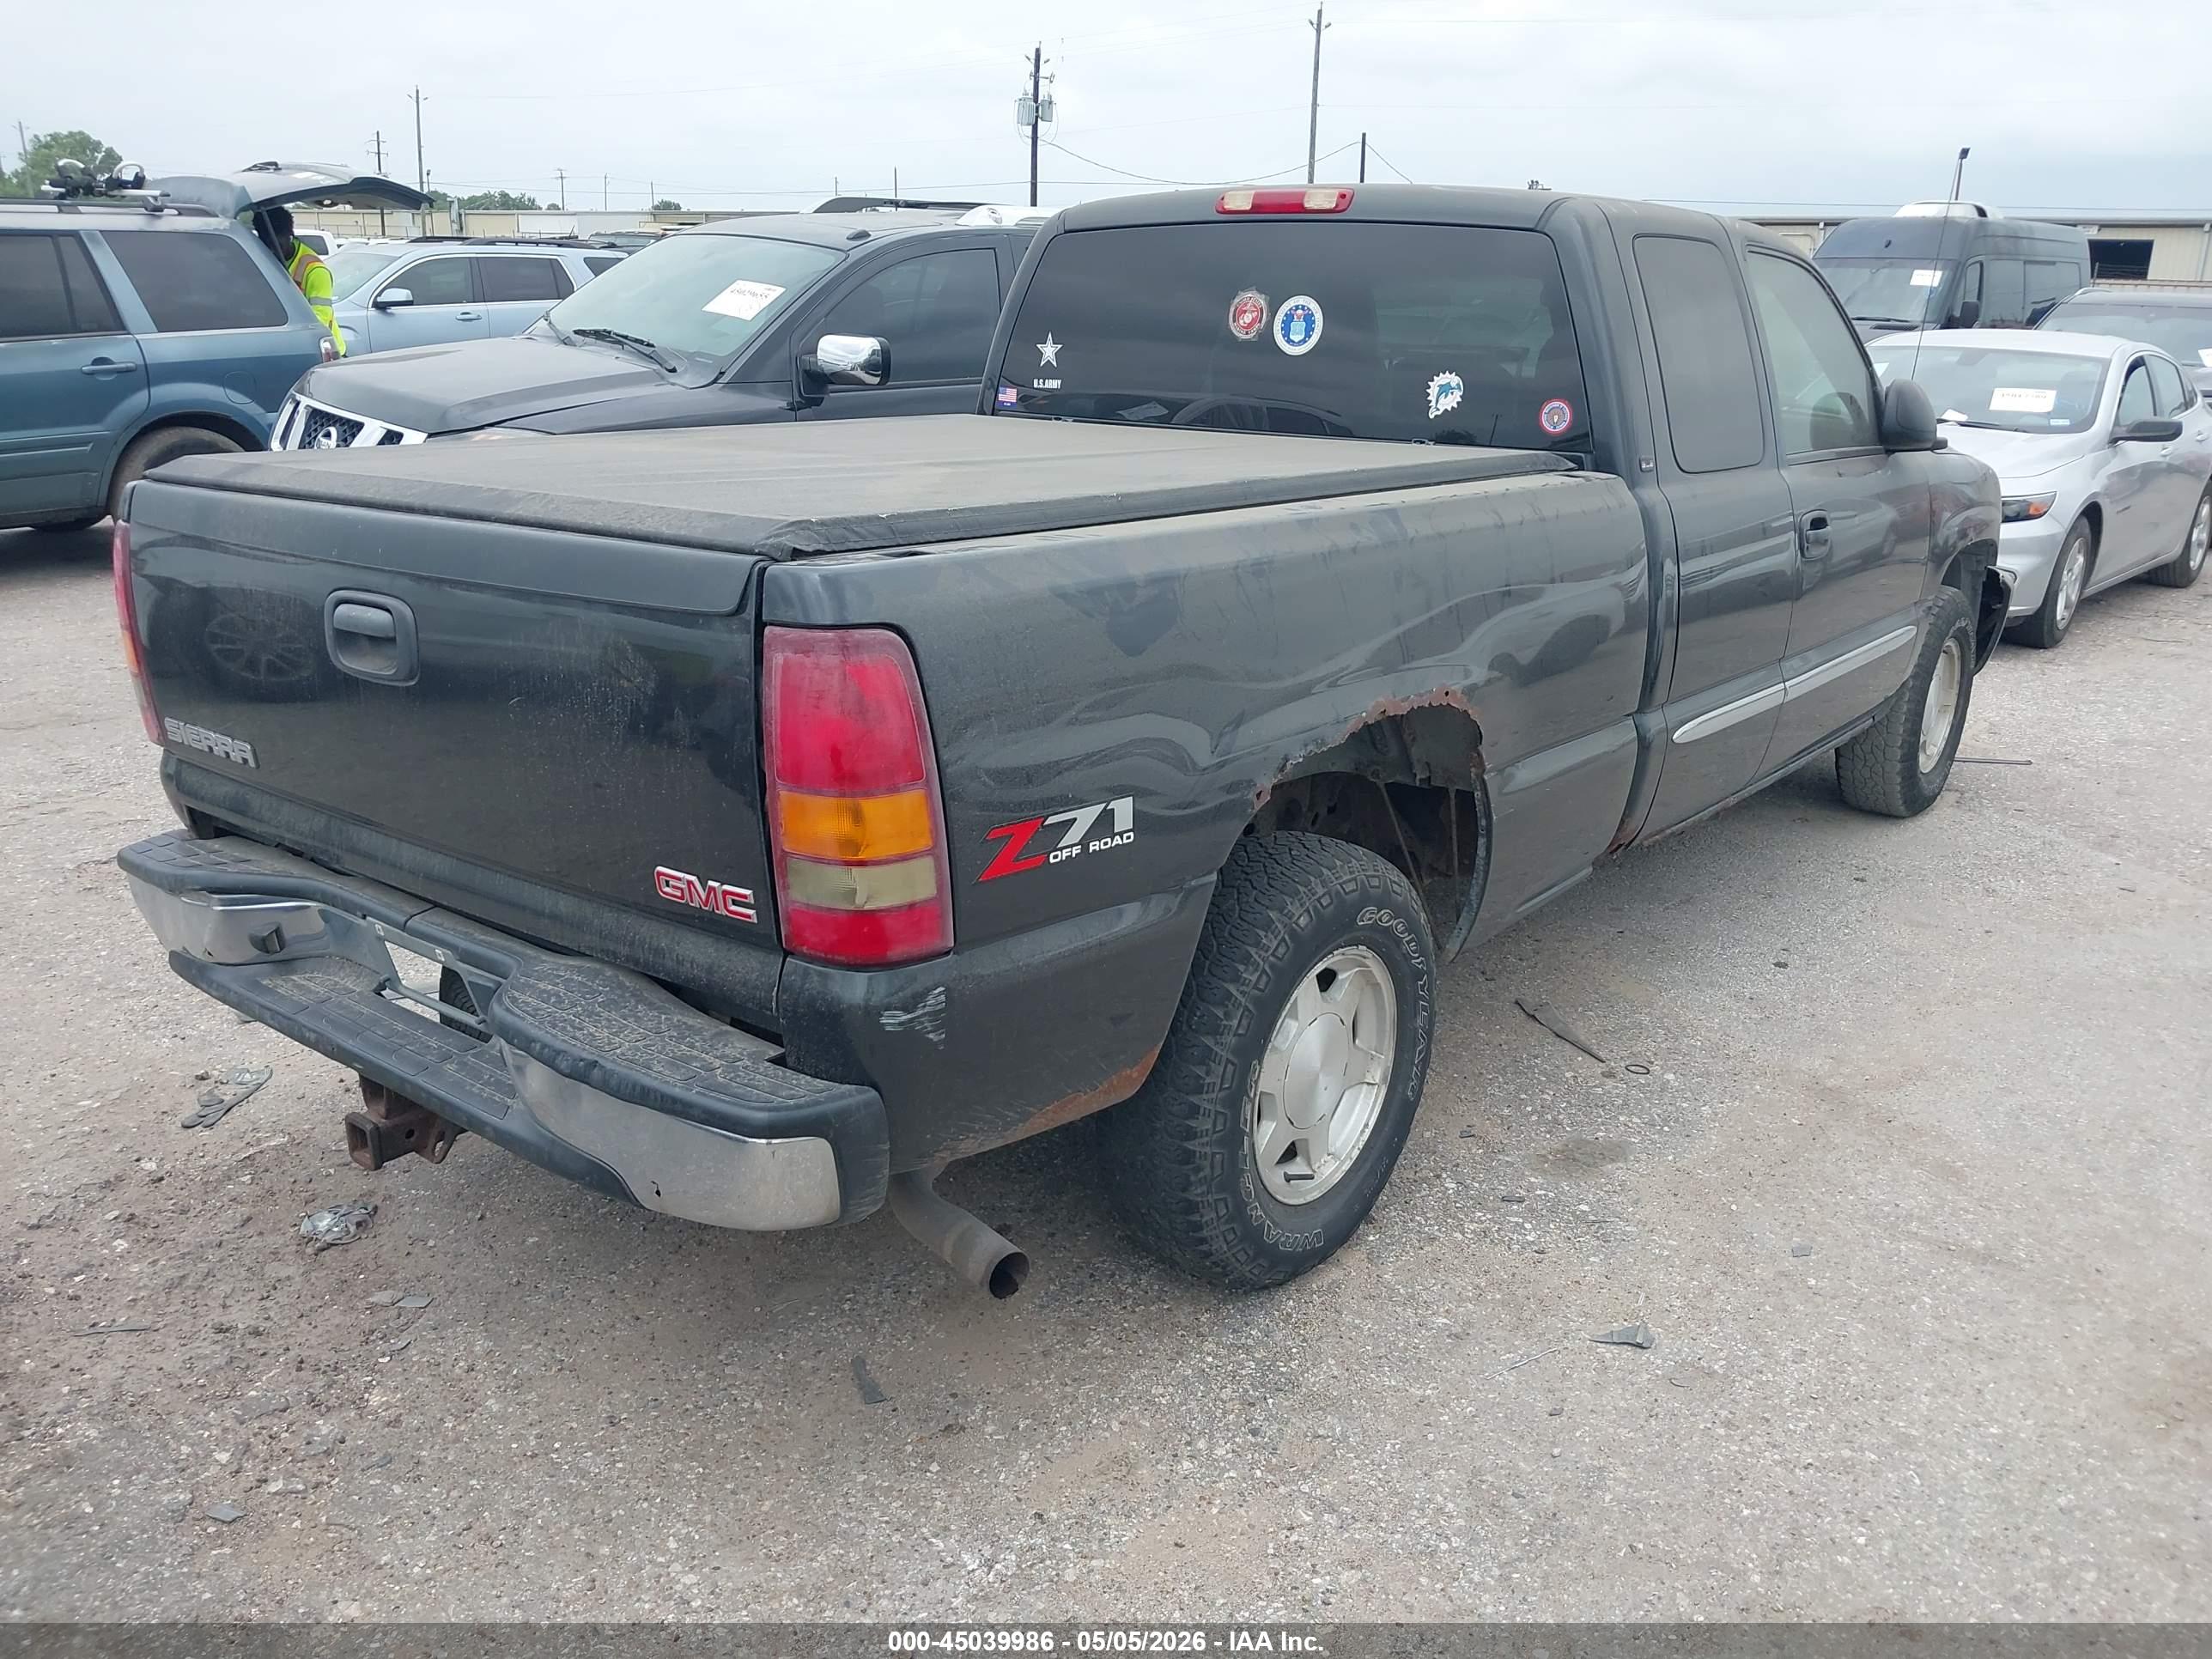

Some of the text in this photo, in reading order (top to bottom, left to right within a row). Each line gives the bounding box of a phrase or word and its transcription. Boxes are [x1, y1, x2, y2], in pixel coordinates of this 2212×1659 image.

[164, 716, 258, 769] SIERRA
[978, 796, 1133, 881] Z71
[1049, 831, 1134, 864] OFF ROAD
[654, 866, 757, 923] GMC
[1356, 906, 1430, 1102] GOODYEAR
[1239, 1060, 1324, 1251] WRANGLER
